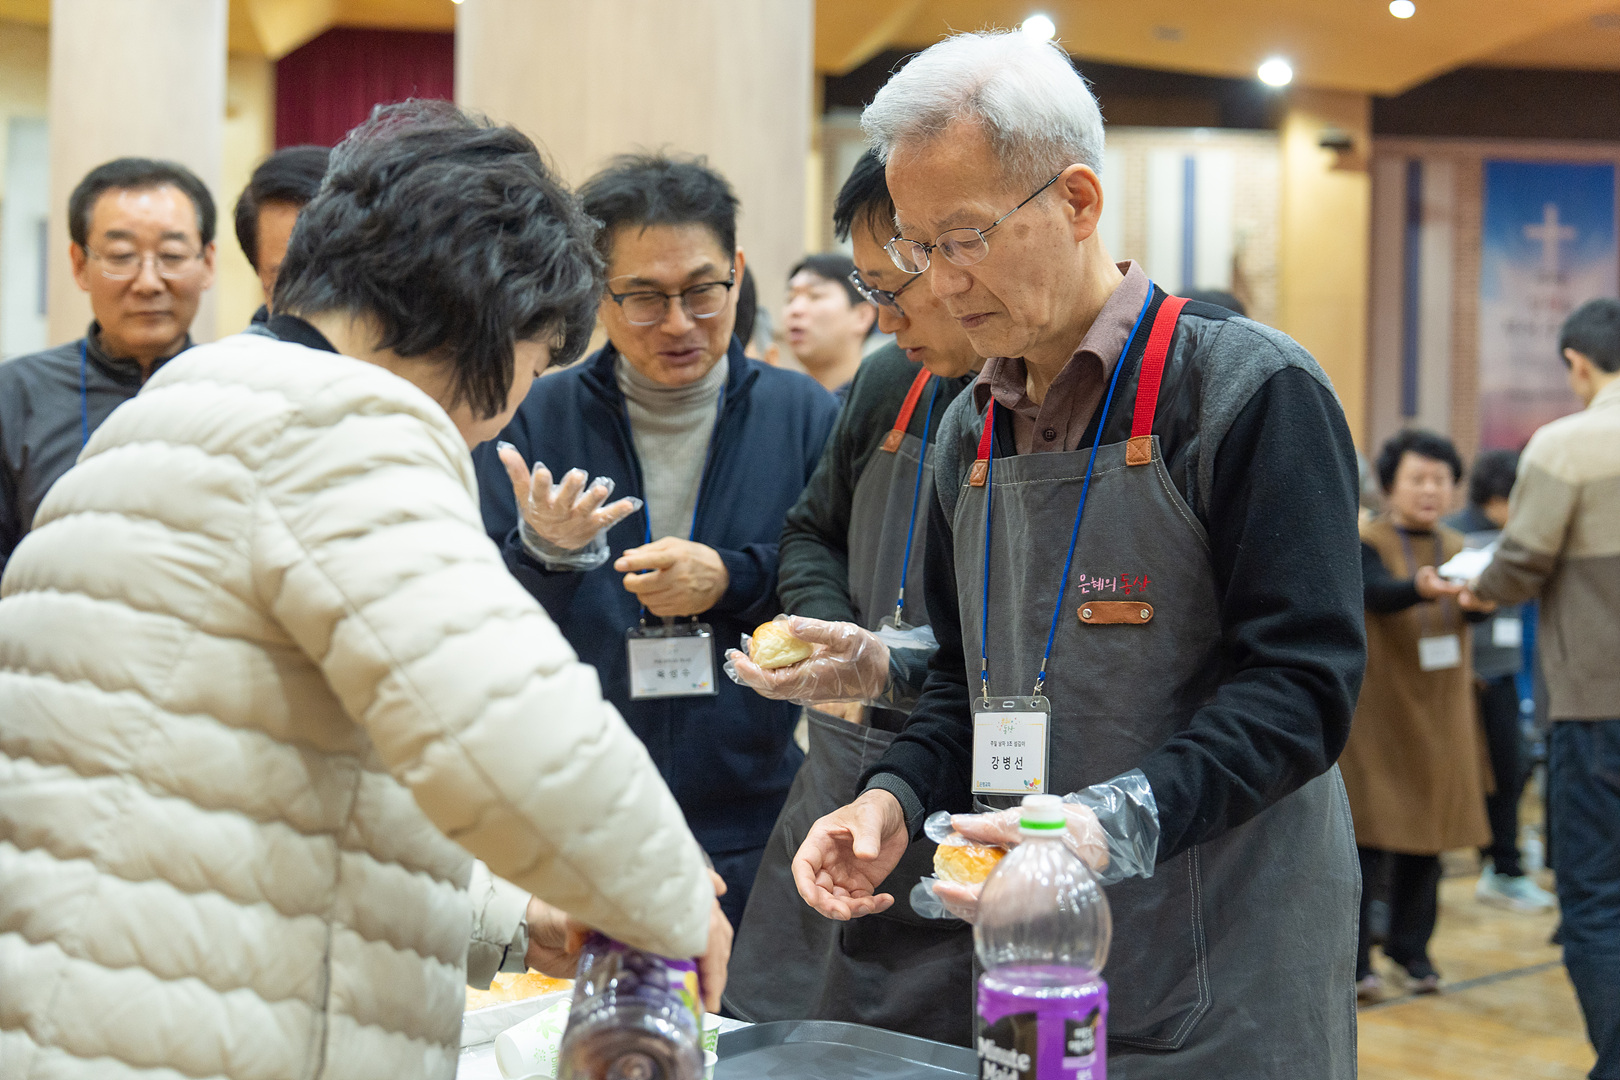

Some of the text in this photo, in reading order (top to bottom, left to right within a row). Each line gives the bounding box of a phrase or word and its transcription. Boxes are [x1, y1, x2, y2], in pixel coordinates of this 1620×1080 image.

[1078, 573, 1151, 595] 은혜의 동산
[991, 756, 1023, 770] 강병선
